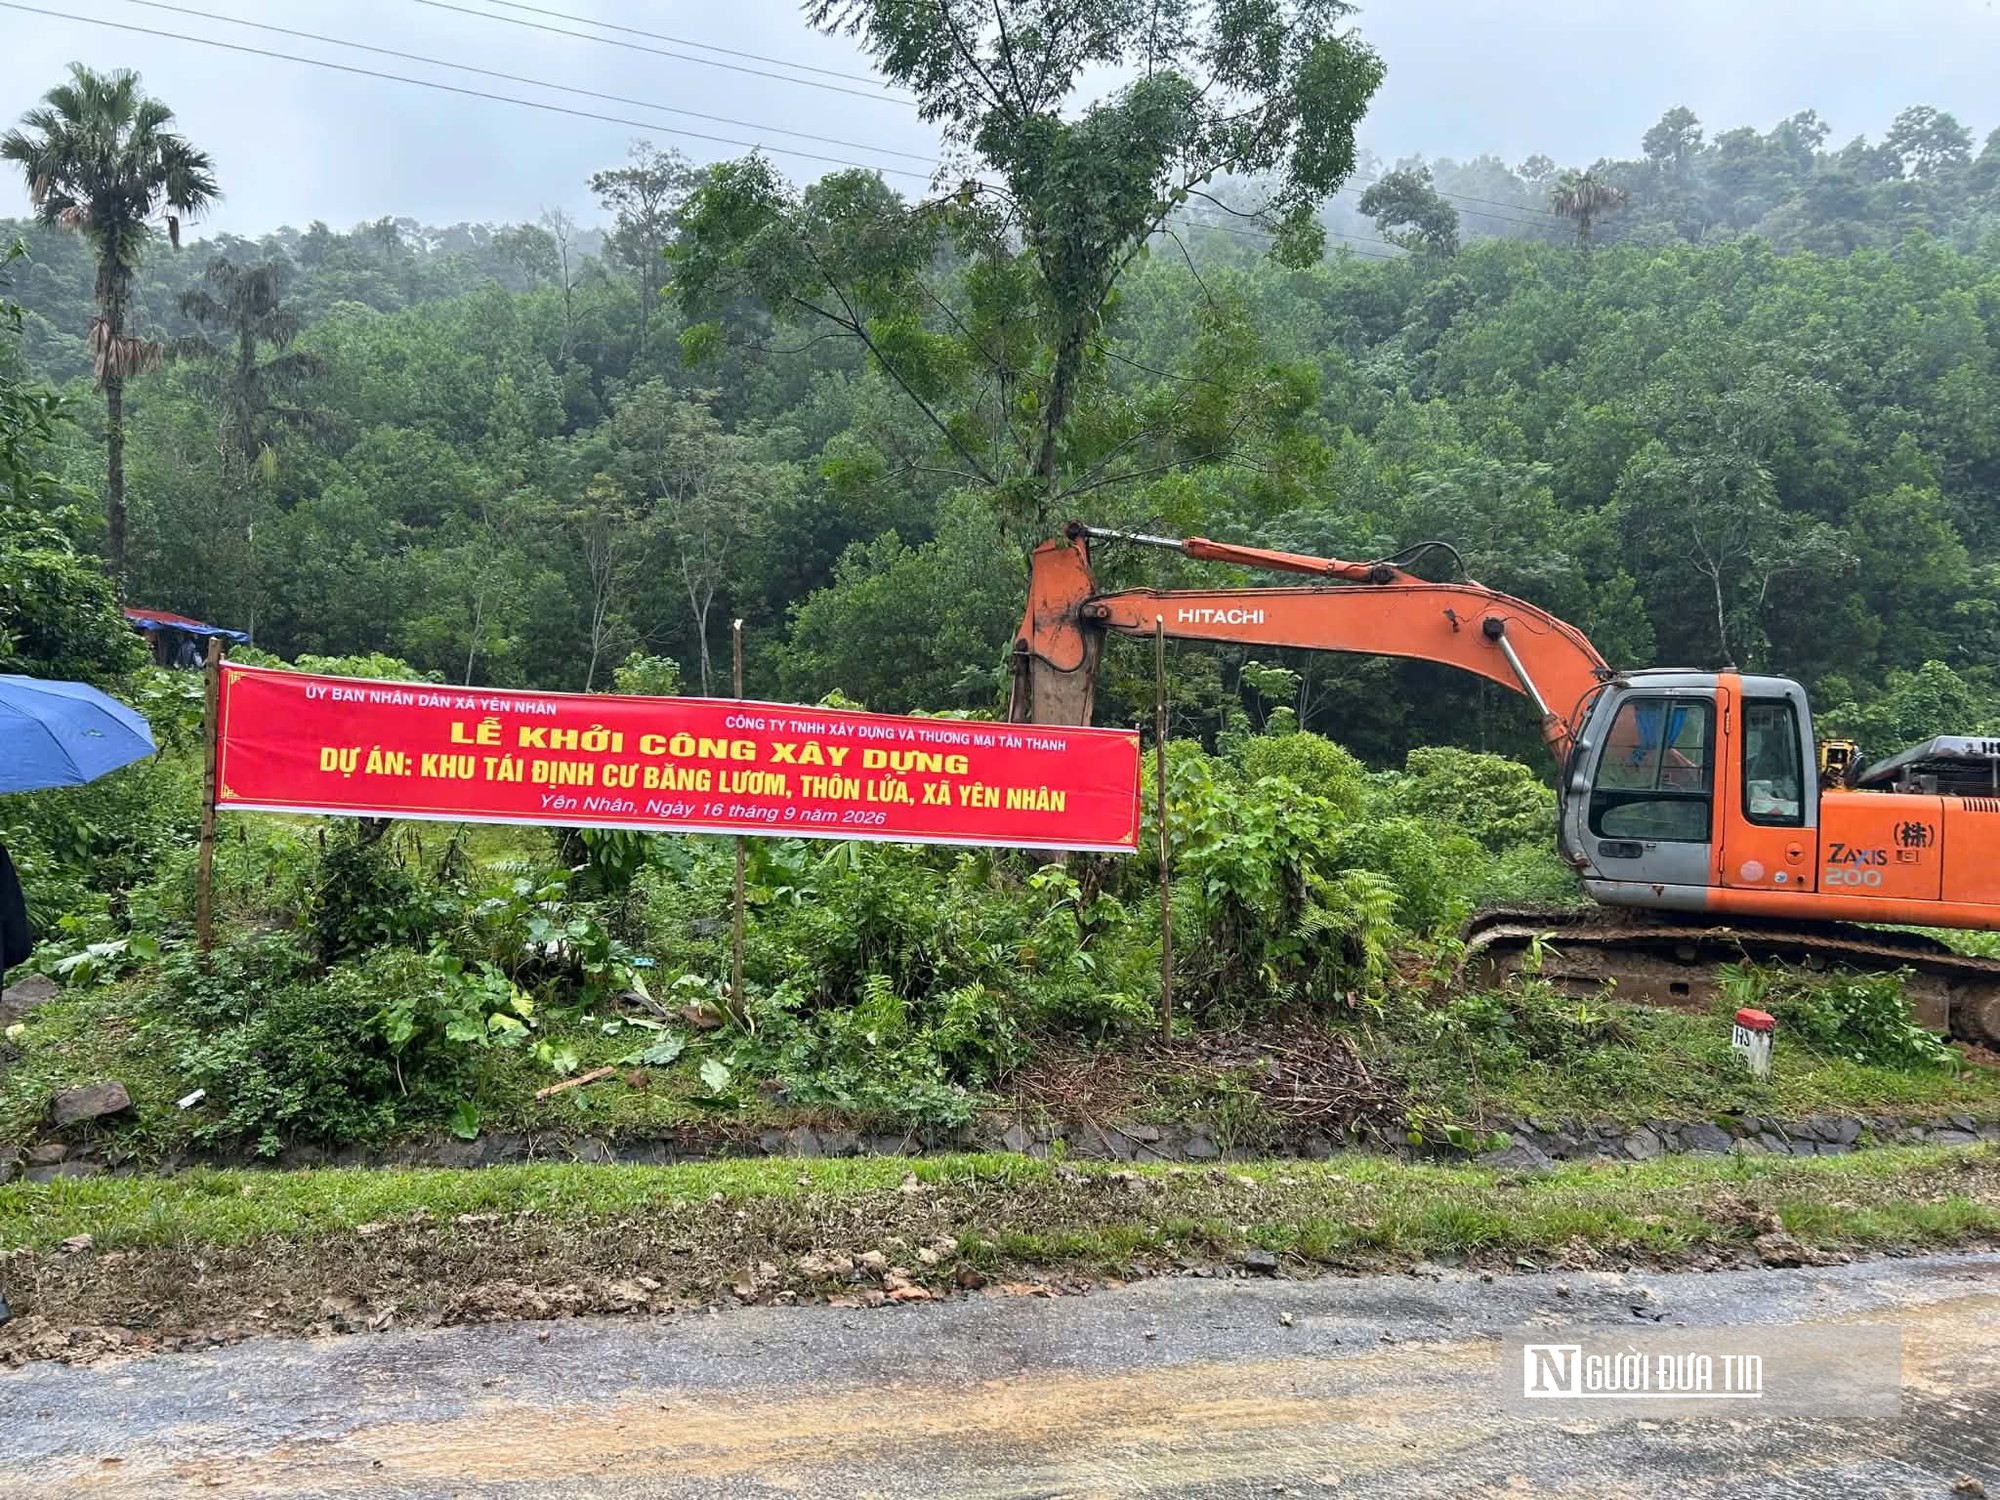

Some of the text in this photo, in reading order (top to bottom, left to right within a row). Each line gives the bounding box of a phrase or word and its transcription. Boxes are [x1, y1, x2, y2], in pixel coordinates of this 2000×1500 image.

[1178, 609, 1264, 625] HITACHI
[332, 687, 364, 702] BAN
[370, 690, 413, 705] NHÂN
[418, 692, 450, 708] DÂN
[455, 695, 475, 710] XÃ
[480, 697, 510, 712] YÊN
[515, 700, 556, 715] NHÂN
[450, 716, 969, 775] LỄ KHỞI CÔNG XÂY DỰNG
[725, 714, 765, 730] CÔNG
[769, 719, 786, 732] TY
[790, 721, 825, 734] TNHH
[829, 722, 855, 736] XÂY
[899, 726, 915, 741] VÀ
[919, 729, 970, 745] THƯƠNG
[974, 734, 995, 747] MẠI
[999, 733, 1022, 748] TÂN
[1026, 738, 1066, 751] THANH
[319, 746, 361, 778] DỰ
[365, 745, 412, 776] ÁN:
[421, 753, 475, 780] KHU
[483, 753, 524, 782] TÁI
[531, 759, 595, 789] ĐỊNH
[602, 763, 640, 788] CƯ
[643, 763, 711, 792] BĂNG
[800, 773, 860, 801] THÔN
[867, 773, 915, 806] LỬA,
[921, 779, 951, 806] XÃ
[959, 781, 1000, 809] YÊN
[1005, 786, 1066, 812] NHÂN
[540, 793, 887, 825] Yên Nhân, Ngày 16 tháng 9 năm 2026
[1827, 843, 1888, 867] ZAXIS
[1825, 867, 1882, 887] 200
